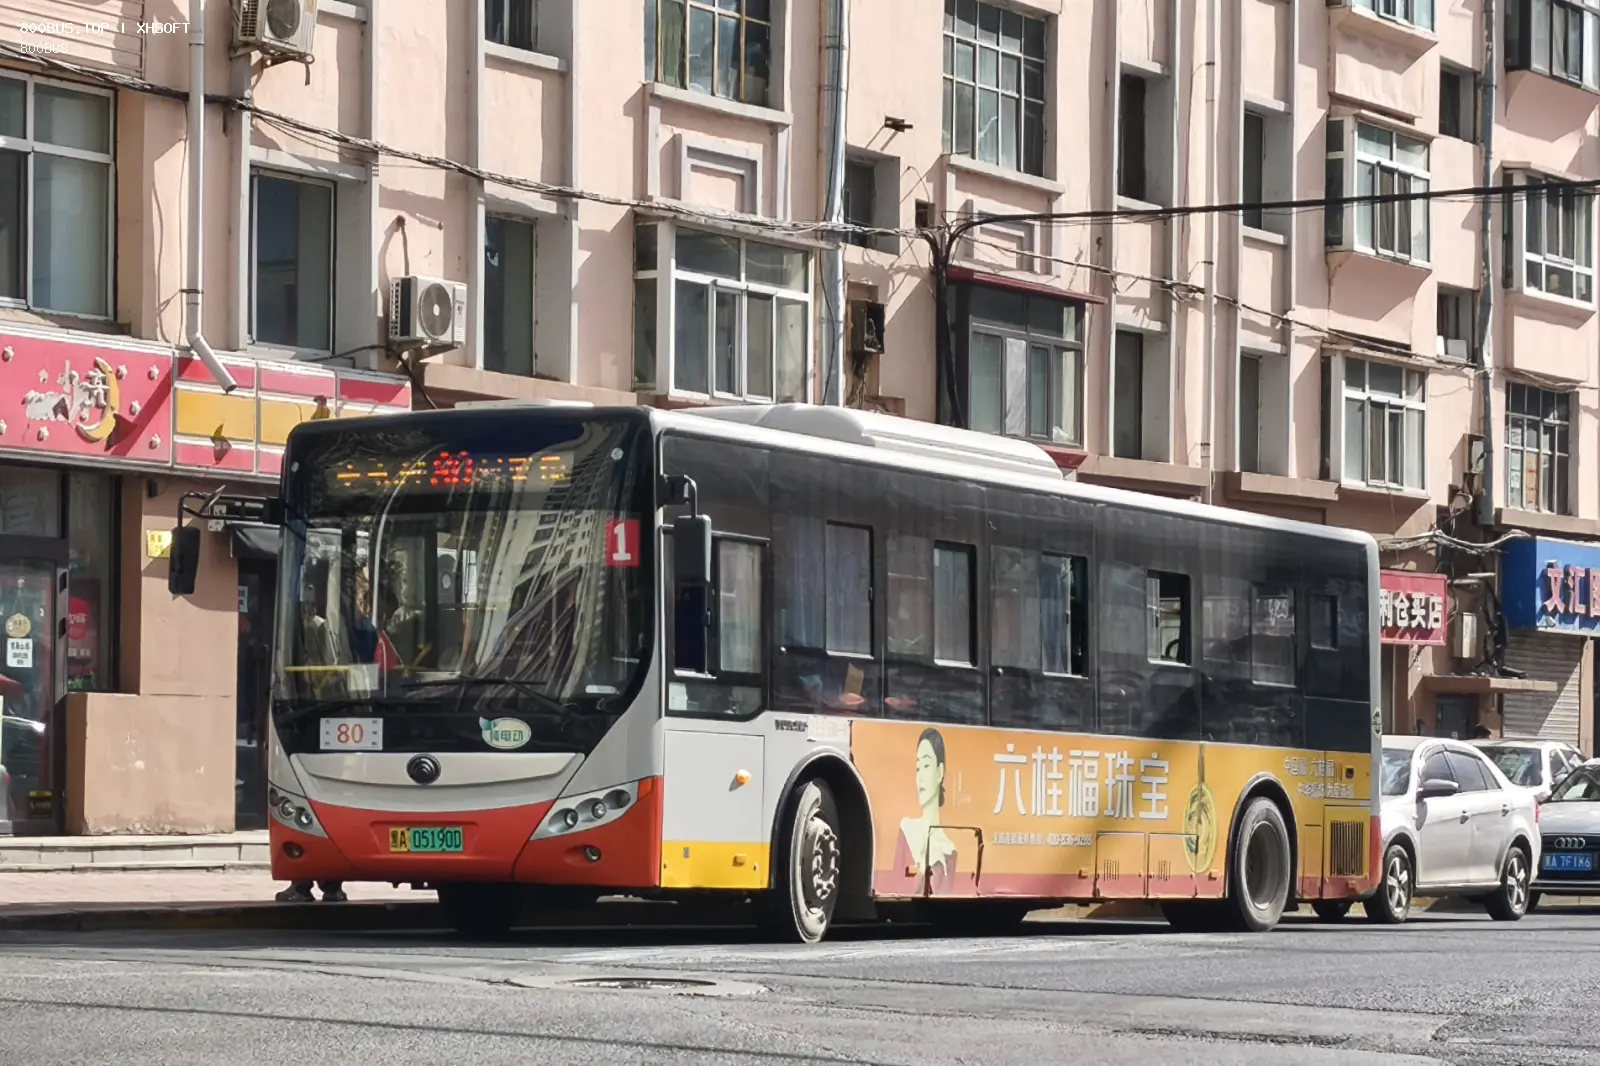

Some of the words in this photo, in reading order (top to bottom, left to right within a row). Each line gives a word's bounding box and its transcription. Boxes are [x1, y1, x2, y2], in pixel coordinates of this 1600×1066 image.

[612, 521, 632, 561] 1
[337, 722, 365, 744] 80
[993, 743, 1170, 820] 六桂福珠宝
